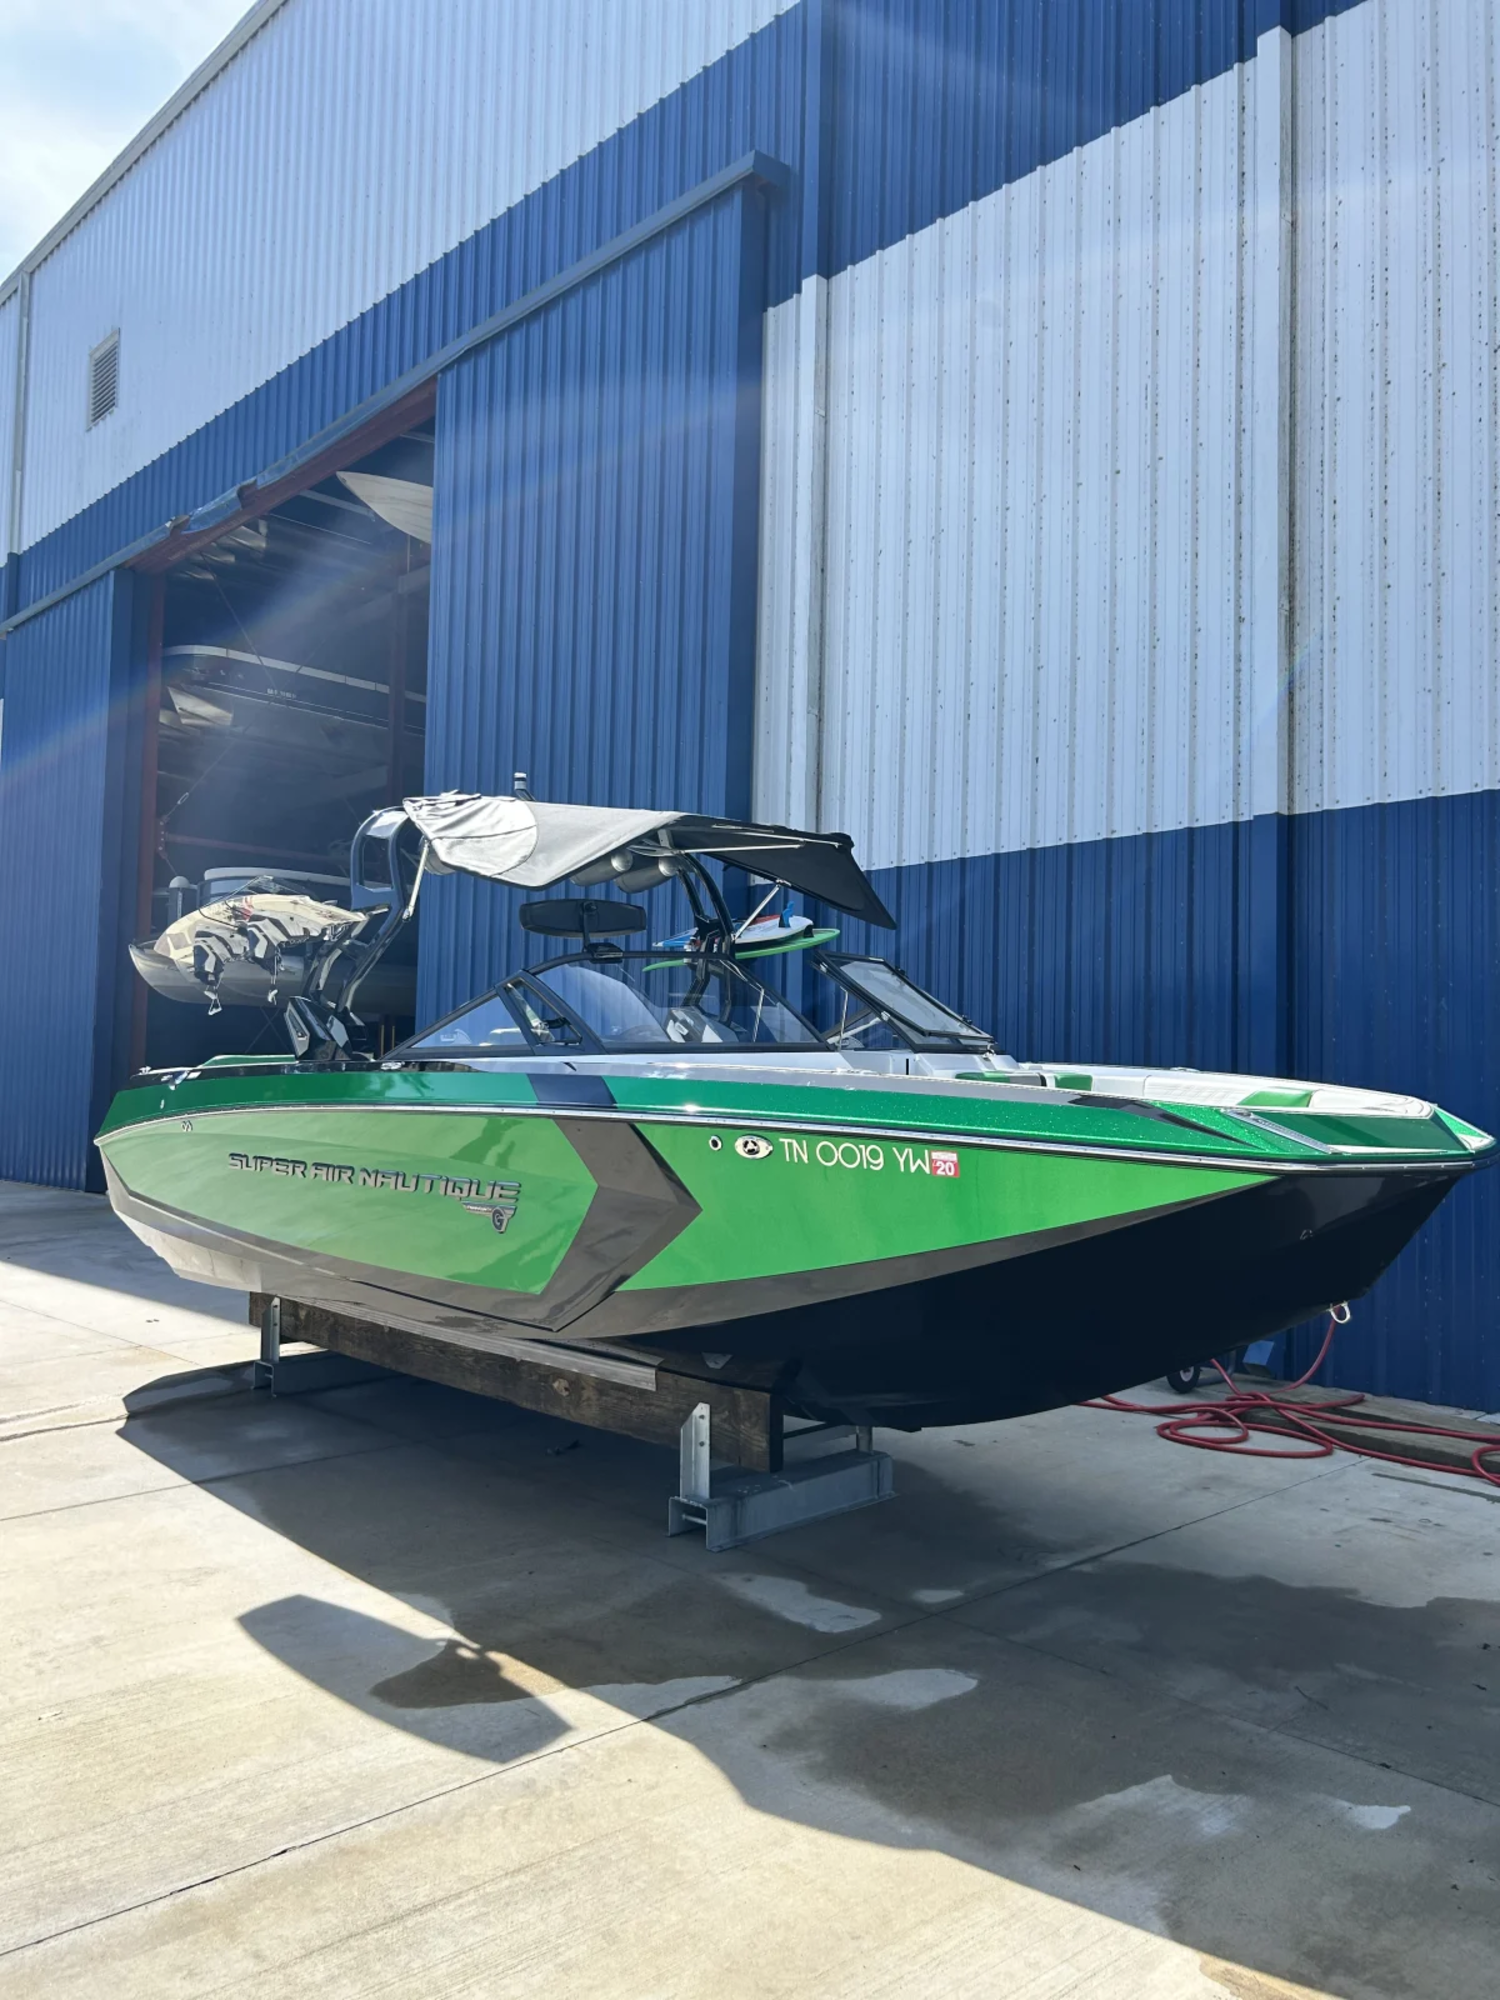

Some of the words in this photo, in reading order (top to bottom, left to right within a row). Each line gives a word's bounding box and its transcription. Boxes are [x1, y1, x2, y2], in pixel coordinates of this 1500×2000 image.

[228, 1152, 307, 1178] SUPER
[309, 1162, 355, 1184] AIR
[358, 1166, 521, 1203] NAUTIQUE
[779, 1138, 809, 1164] TN
[815, 1140, 885, 1171] 0019
[892, 1147, 931, 1175] YW
